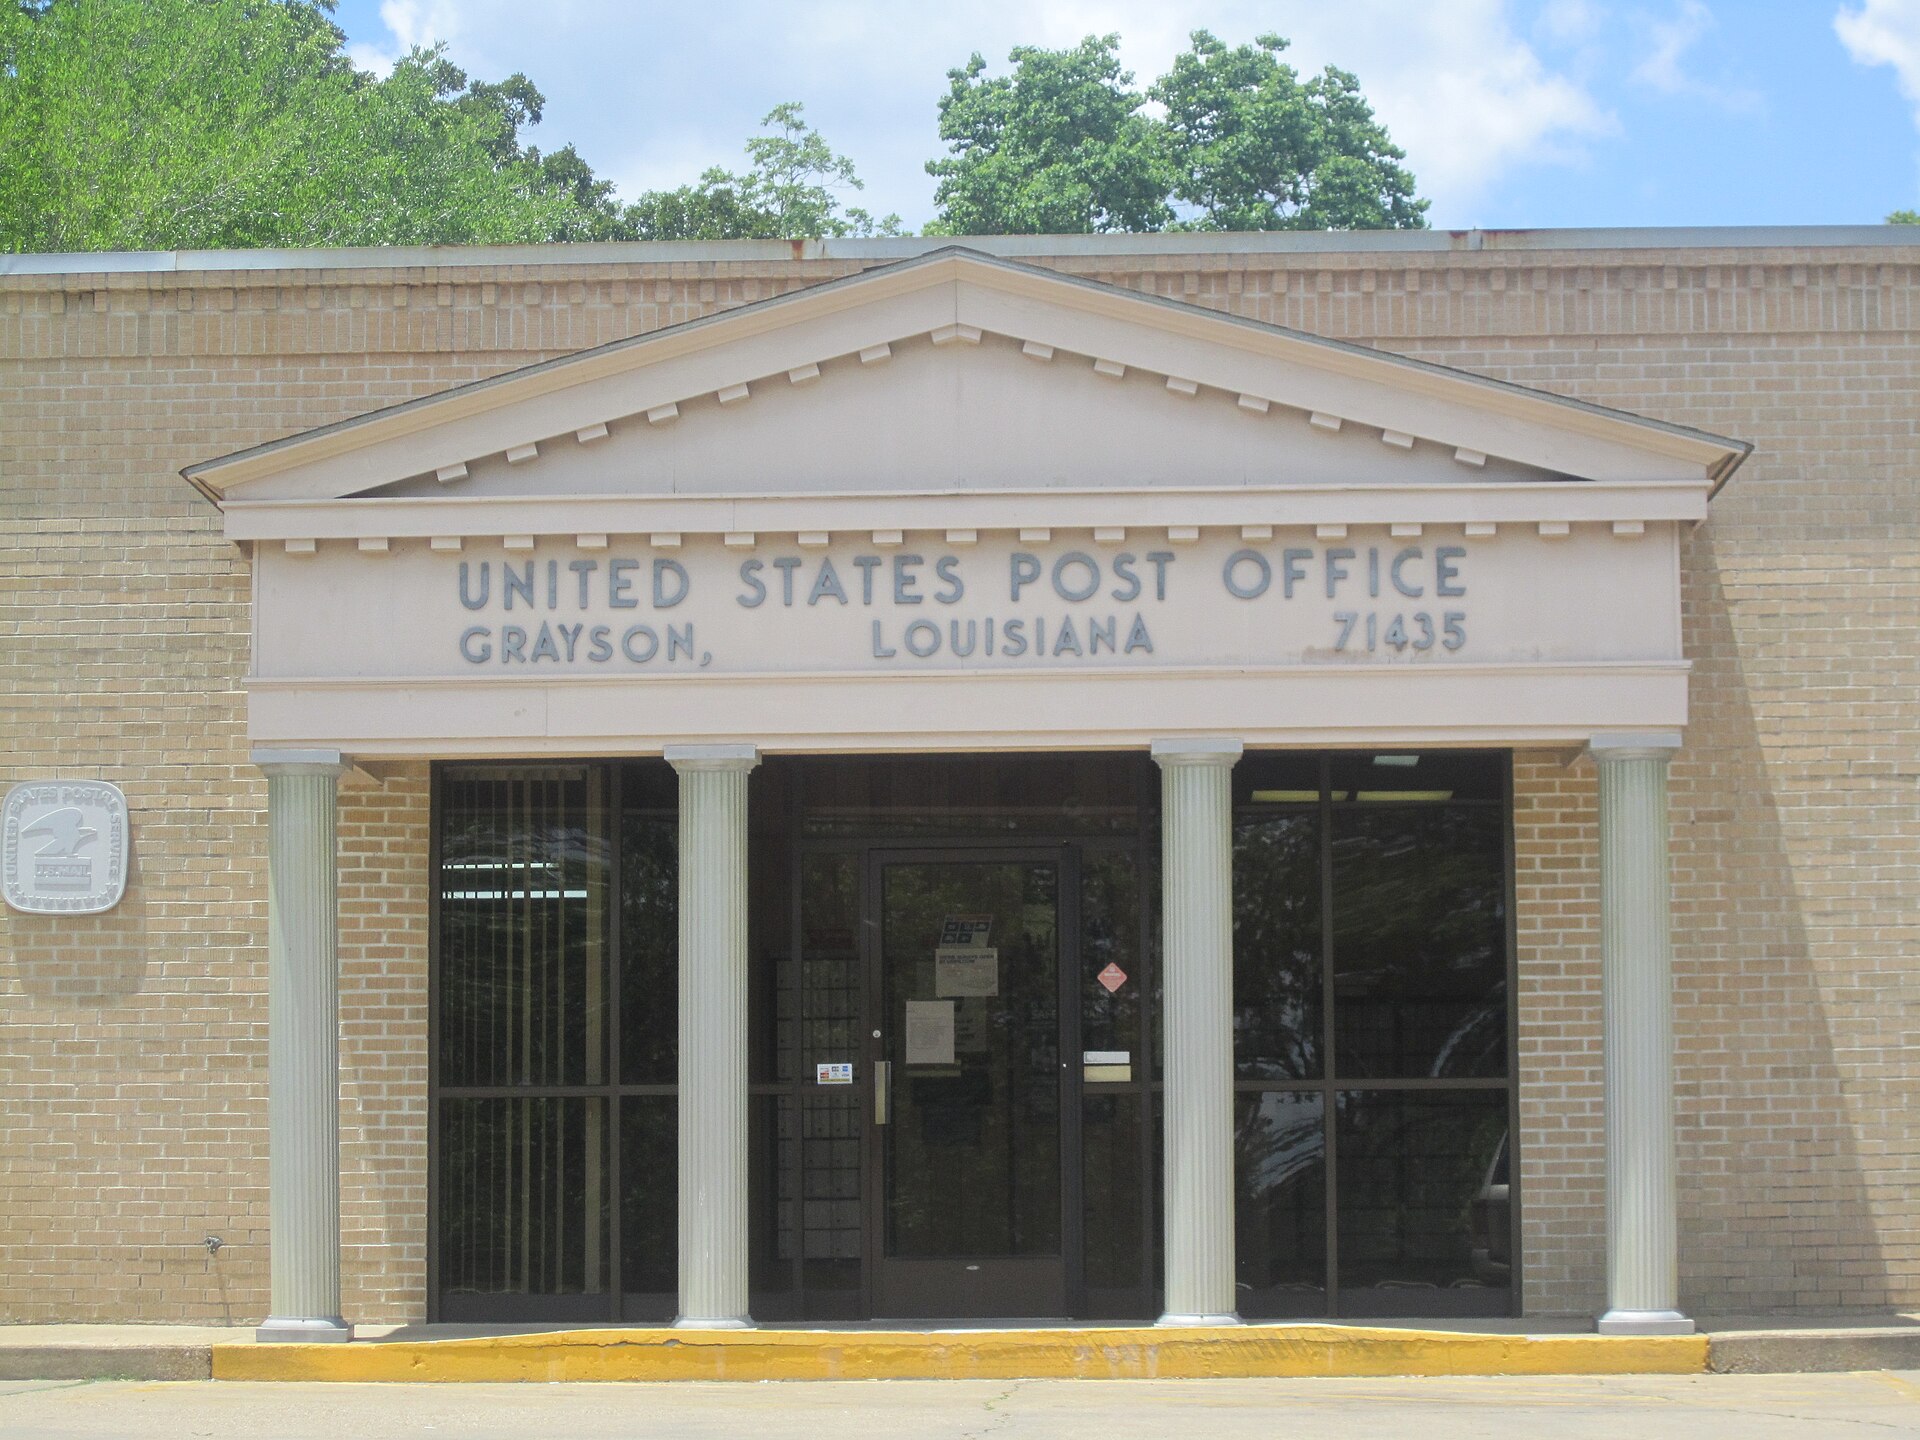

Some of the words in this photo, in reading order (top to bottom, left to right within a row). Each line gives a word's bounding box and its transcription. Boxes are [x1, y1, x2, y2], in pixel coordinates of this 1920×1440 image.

[459, 558, 690, 610] UNITED
[736, 555, 965, 608] STATES
[1009, 550, 1176, 602] POST
[1222, 547, 1467, 599] OFFICE
[459, 621, 712, 667] GRAYSON,
[872, 612, 1154, 658] LOUISIANA
[1333, 611, 1467, 652] 71435
[9, 786, 59, 817] STATES
[61, 786, 119, 813] POSTAL
[6, 816, 18, 877] UNITED
[108, 813, 122, 881] SERVICE
